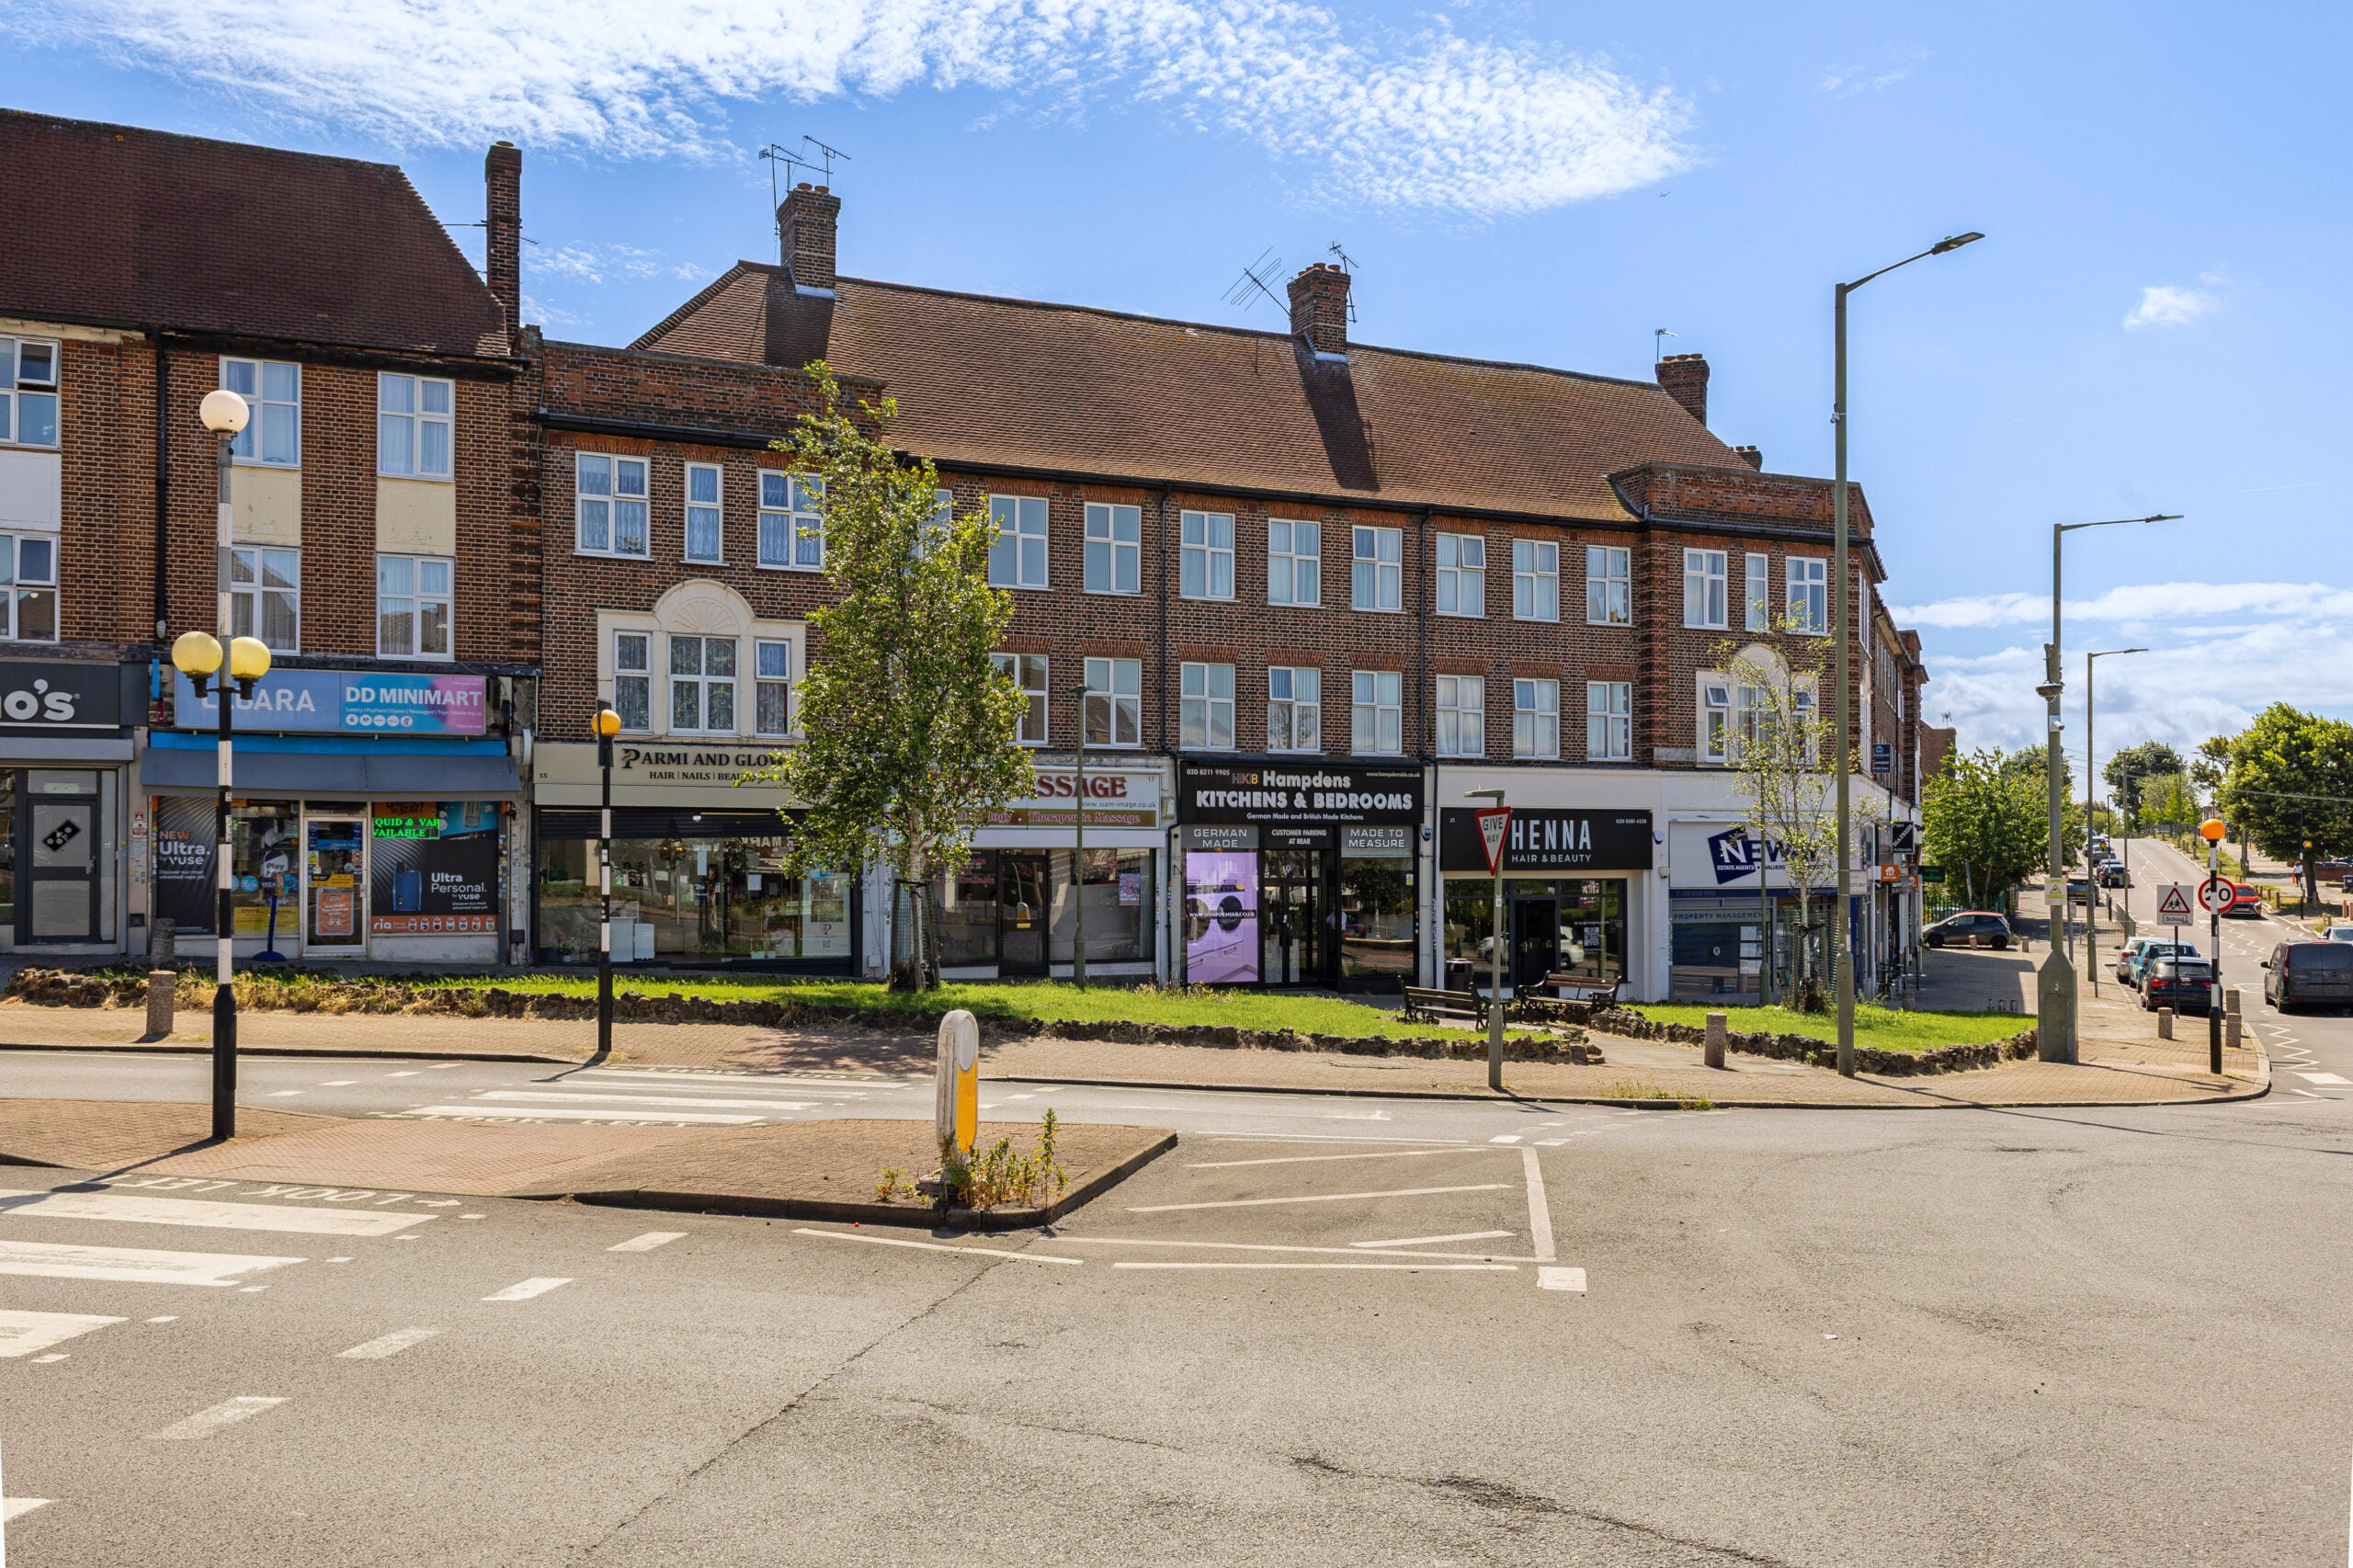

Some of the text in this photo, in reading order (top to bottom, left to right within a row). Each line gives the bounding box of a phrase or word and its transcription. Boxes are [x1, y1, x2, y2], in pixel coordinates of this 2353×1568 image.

[0, 678, 75, 721] o's
[346, 687, 482, 707] DD MINIMART
[693, 753, 730, 767] AND
[649, 771, 676, 779] HAIR
[682, 772, 710, 780] NAILS
[1263, 770, 1351, 790] Hampdens
[1197, 790, 1413, 810] KITCHENS & BEDROOMS
[404, 818, 415, 826] &
[1029, 811, 1092, 824] Therapeuic
[1094, 812, 1141, 824] Massage
[1483, 817, 1504, 831] GIVE
[159, 831, 190, 840] NEW
[1193, 829, 1247, 837] GERMAN
[1350, 829, 1404, 837] MADE TO
[1511, 819, 1592, 850] HENNA
[1349, 839, 1404, 847] MEASURE
[1486, 835, 1500, 844] WAY
[159, 841, 211, 855] Ultra.
[169, 857, 204, 865] vuse
[267, 862, 285, 871] Play
[1281, 864, 1291, 874] 19
[431, 872, 463, 882] Ultra
[431, 882, 487, 893] Personal.
[1673, 911, 1768, 919] PROPERTY MANAGEMEN
[373, 918, 392, 930] ria
[420, 1115, 553, 1123] LOOK
[82, 1175, 414, 1205] LOOK LEFT
